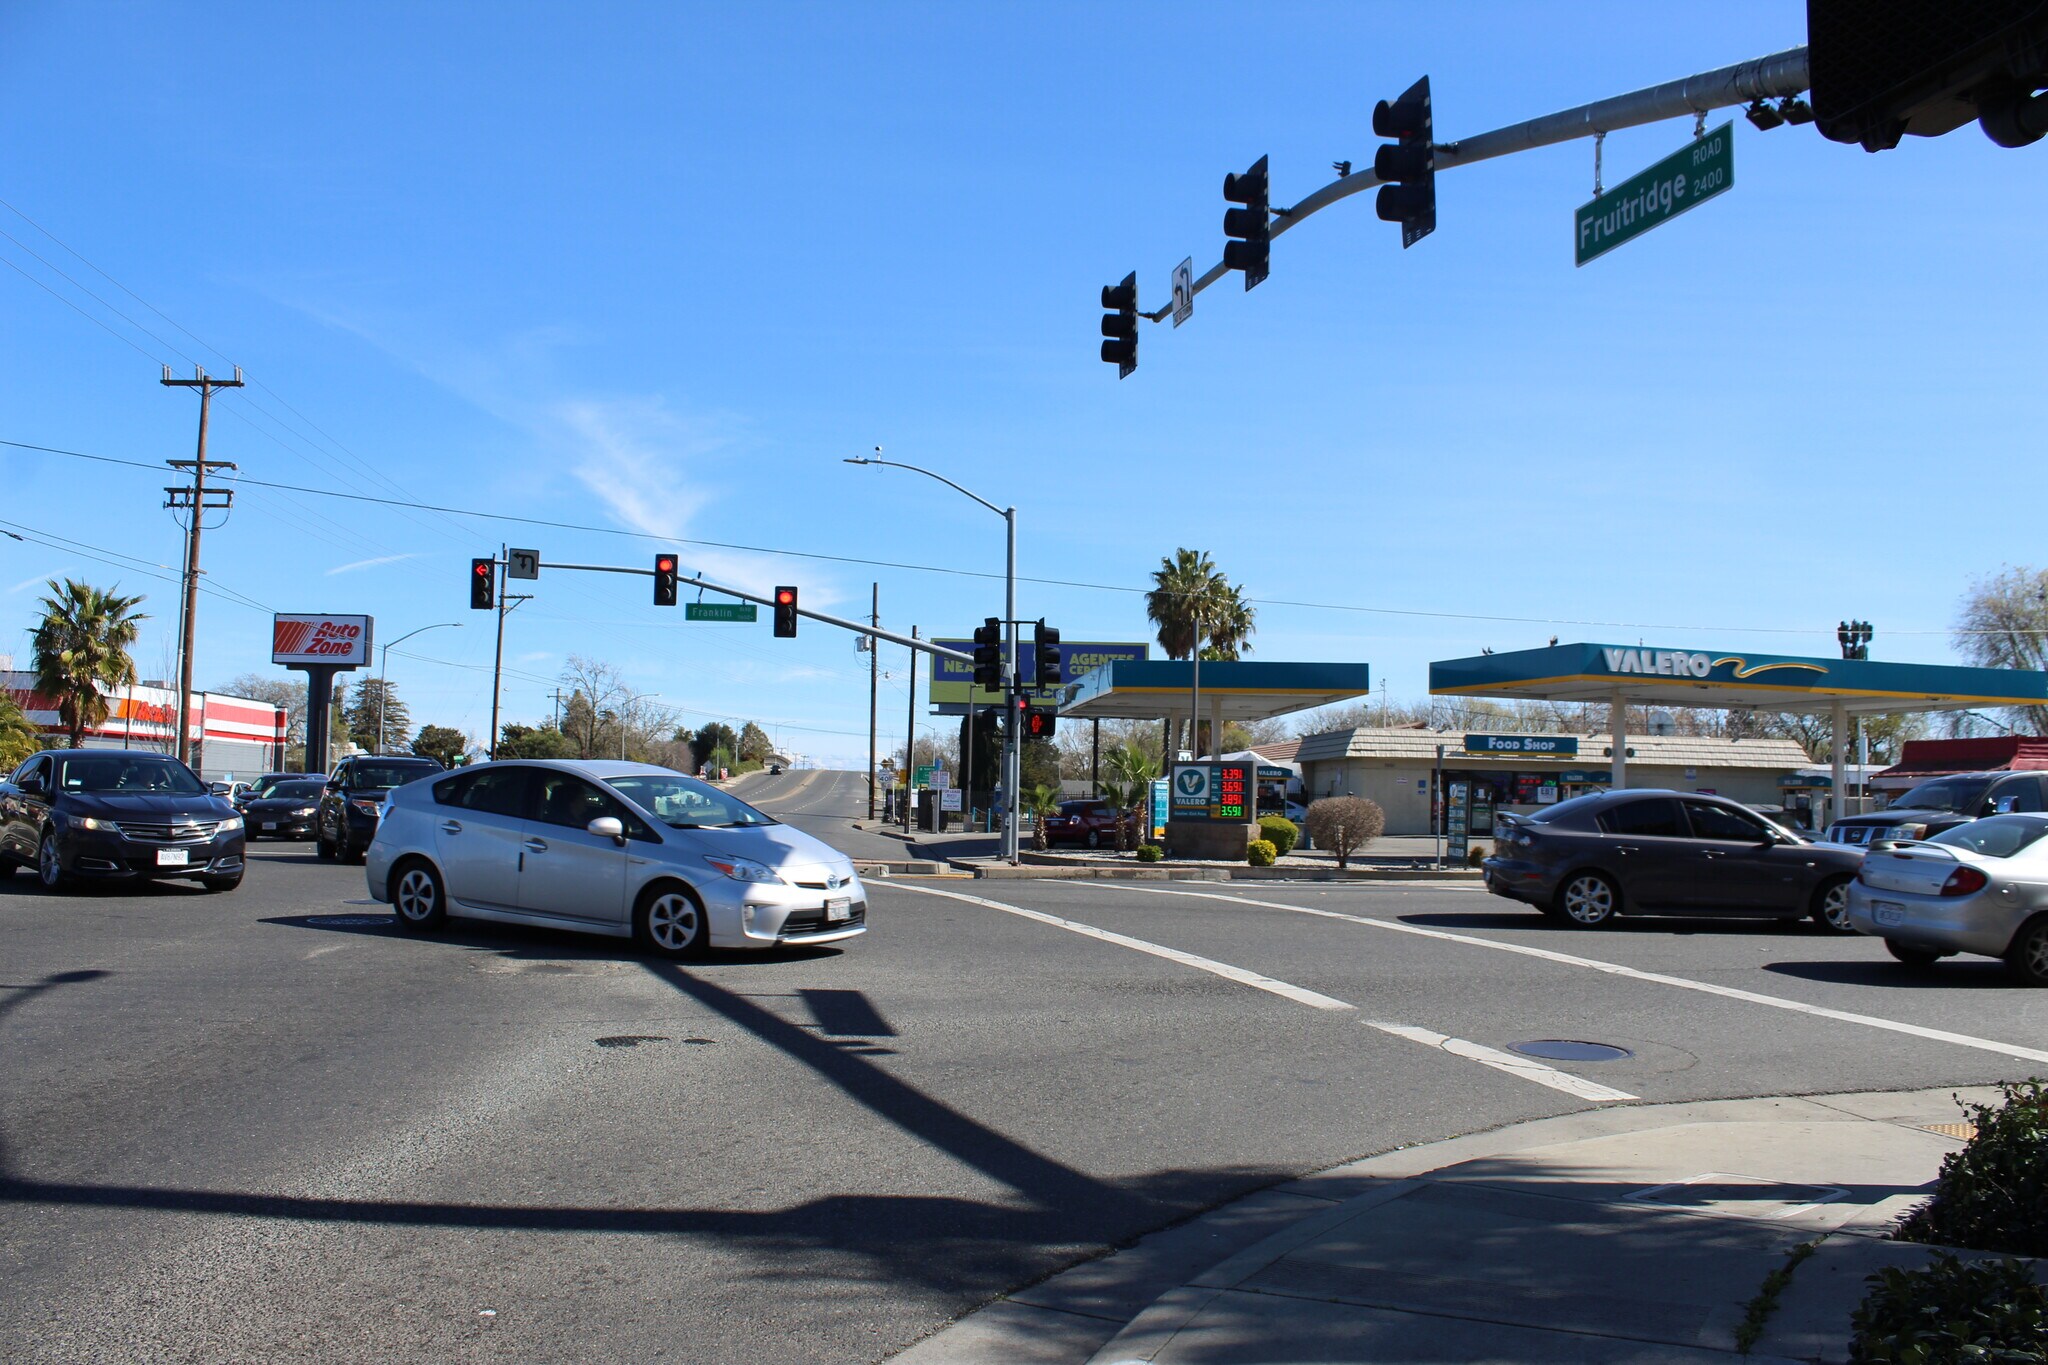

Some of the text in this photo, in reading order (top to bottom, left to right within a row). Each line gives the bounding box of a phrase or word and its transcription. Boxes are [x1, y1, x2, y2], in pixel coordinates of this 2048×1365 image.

[1693, 137, 1722, 166] ROAD
[1693, 168, 1723, 197] 2400
[1580, 173, 1686, 250] Fruitridge
[692, 607, 732, 617] Franklin
[314, 621, 361, 640] Auto
[304, 638, 353, 656] Zone
[1601, 647, 1711, 678] VALERO
[1175, 798, 1206, 806] VALERO
